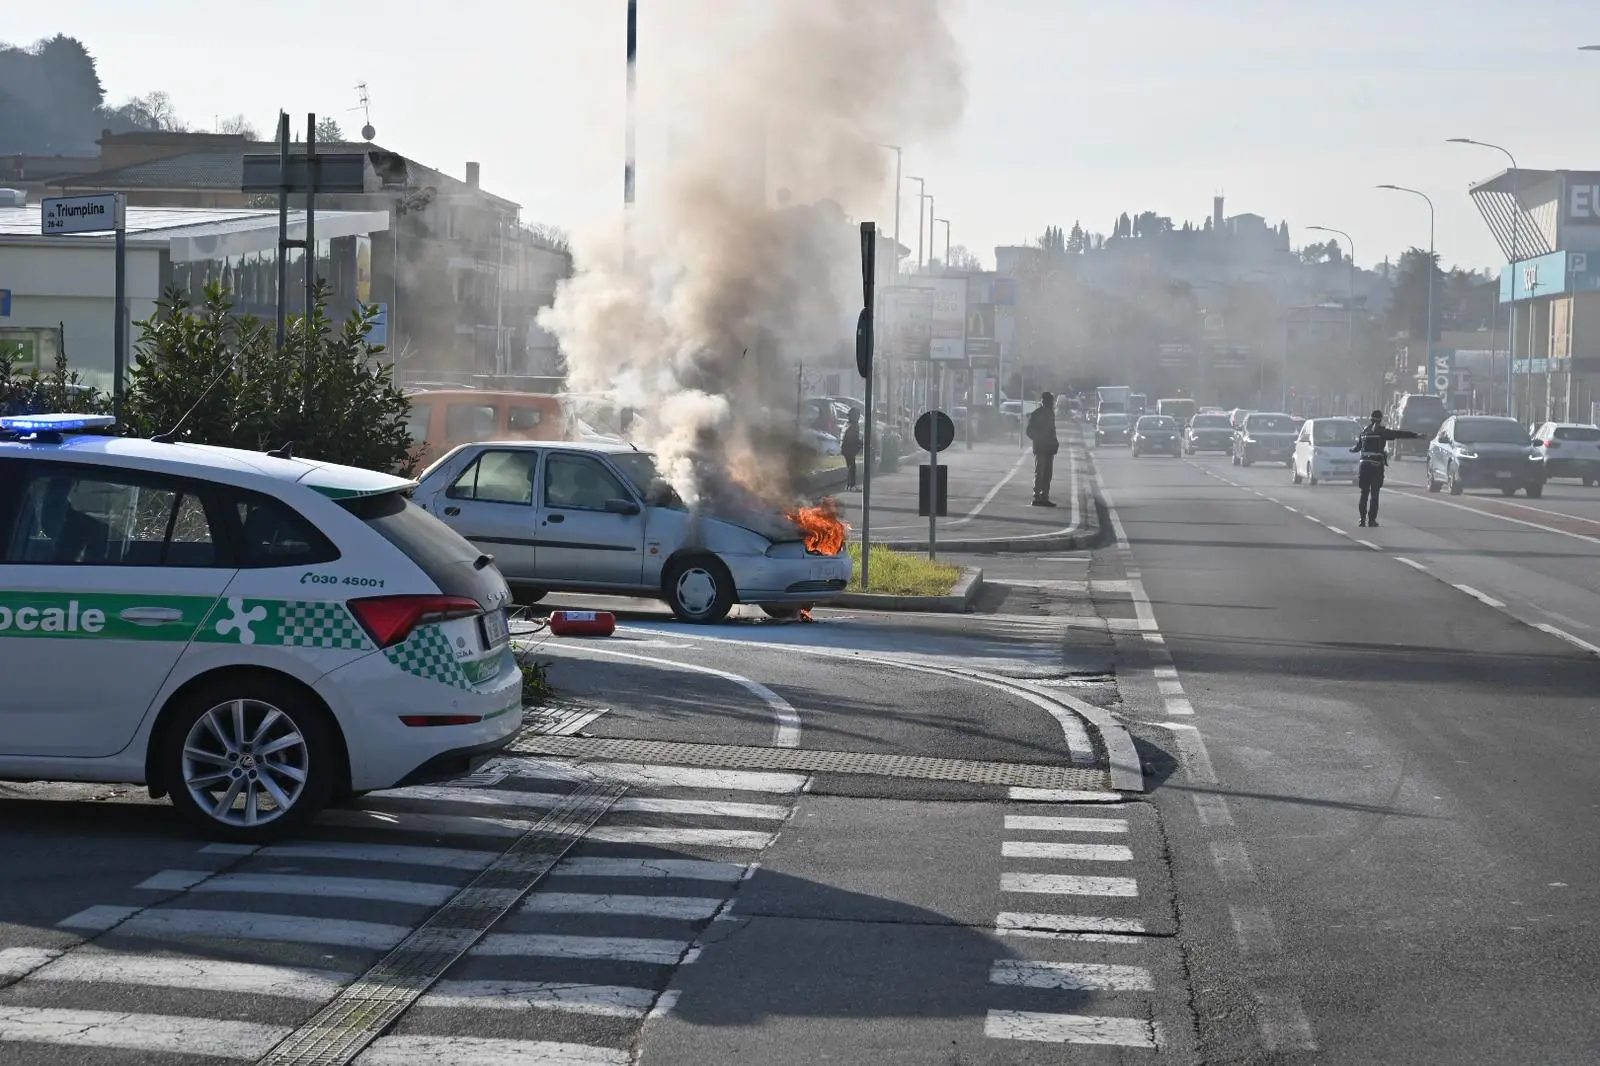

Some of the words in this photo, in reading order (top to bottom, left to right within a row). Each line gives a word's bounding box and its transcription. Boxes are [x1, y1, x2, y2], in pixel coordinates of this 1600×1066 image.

[56, 203, 105, 218] Triumplina
[311, 575, 338, 585] 030
[342, 576, 385, 588] 45001
